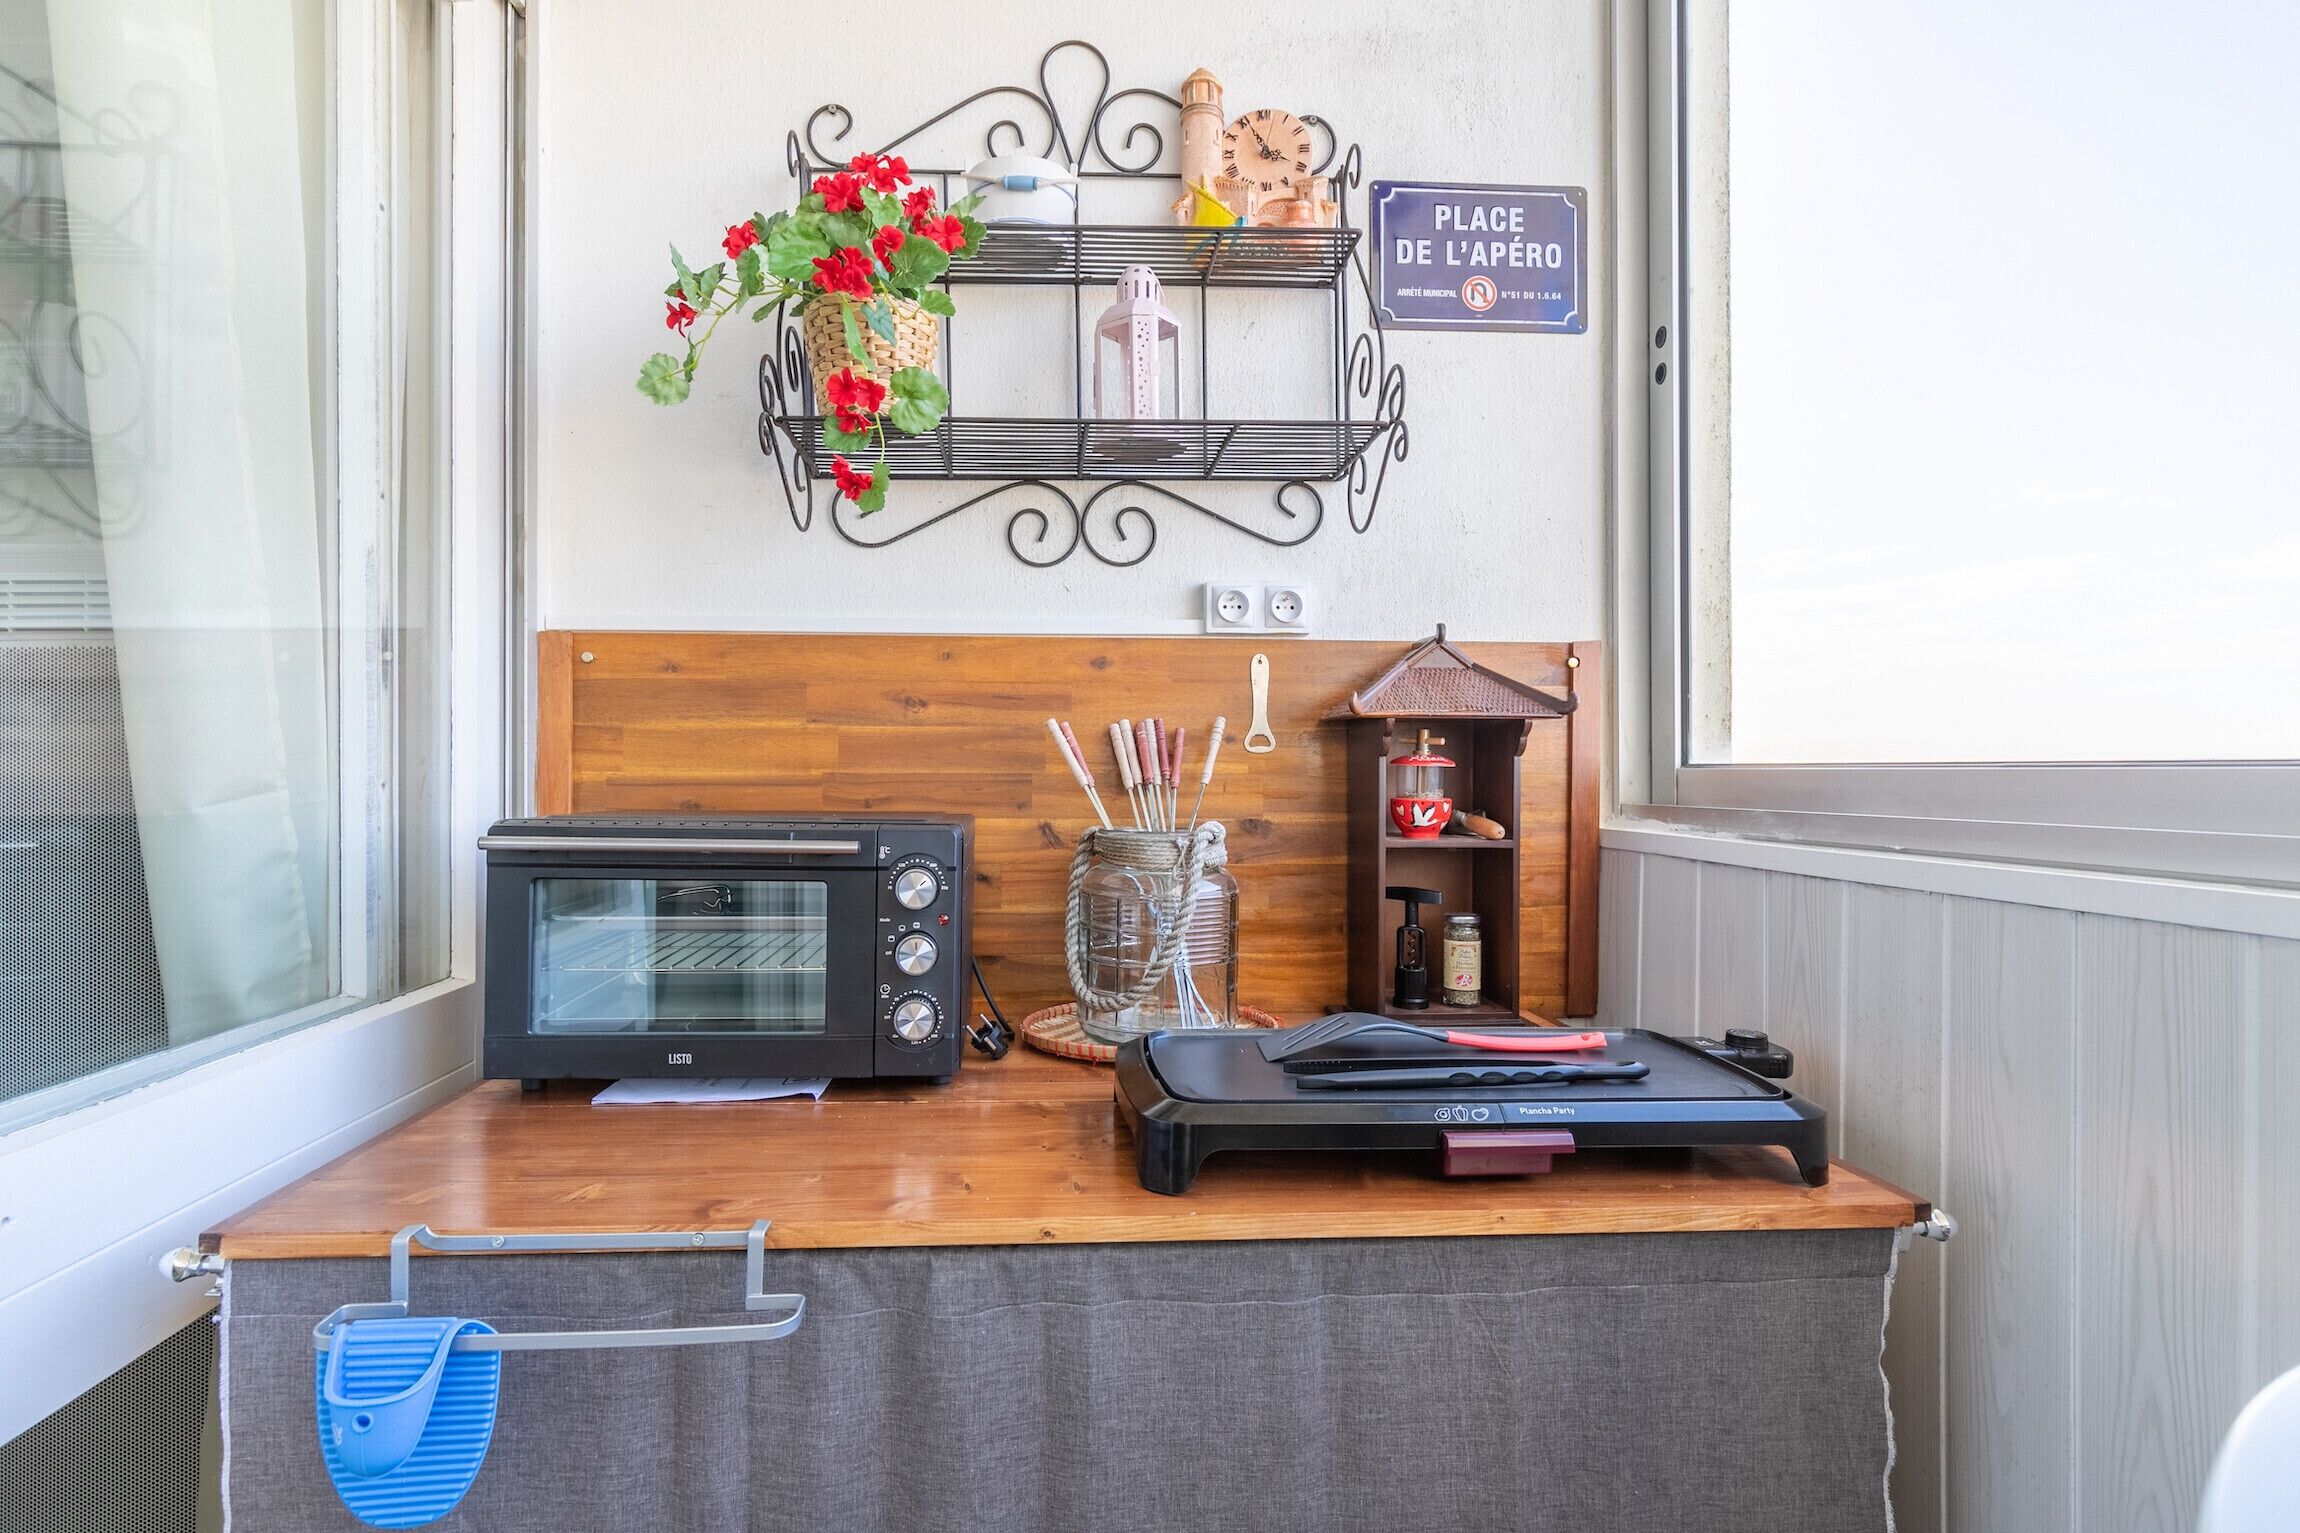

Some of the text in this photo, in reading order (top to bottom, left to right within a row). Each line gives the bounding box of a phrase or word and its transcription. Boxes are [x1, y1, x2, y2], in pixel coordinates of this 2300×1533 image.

[1434, 204, 1525, 233] PLACE
[1396, 238, 1432, 265] DE
[1423, 288, 1457, 298] MUNICIPAL
[1523, 291, 1535, 300] DU
[1537, 291, 1562, 300] 1.6.64
[668, 1053, 693, 1065] LISTO
[1519, 1106, 1575, 1116] Plancha Party
